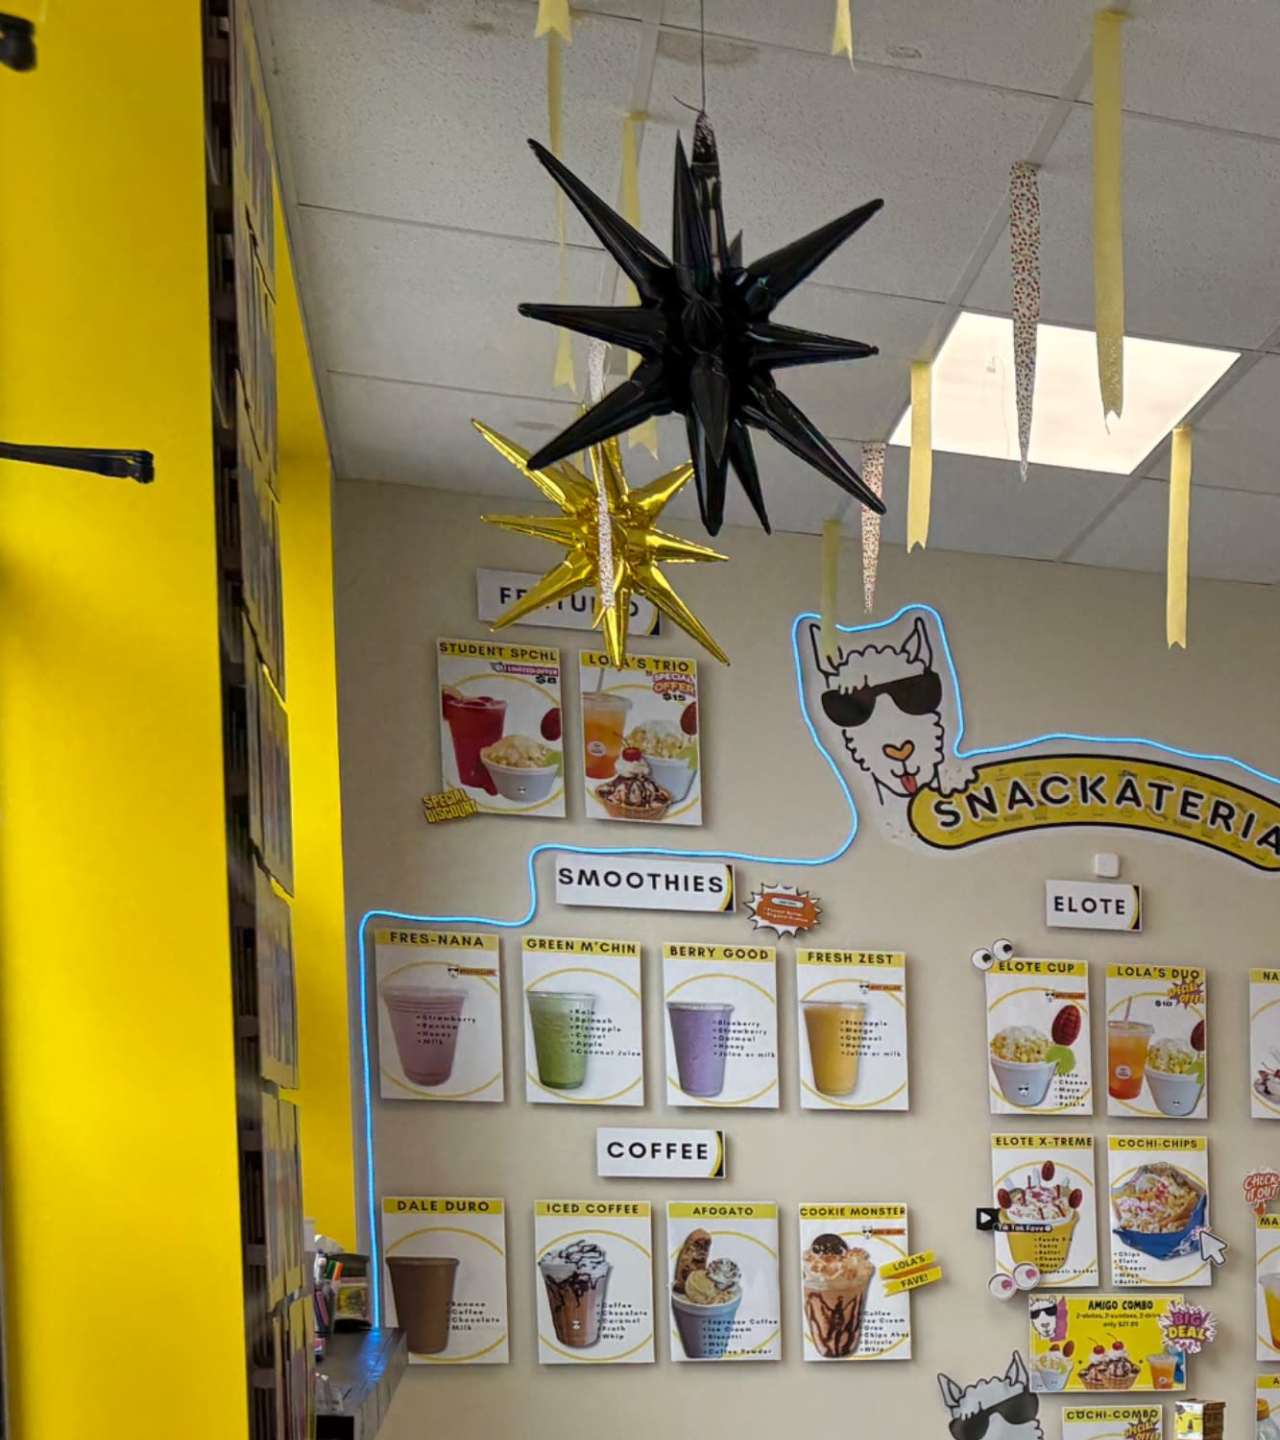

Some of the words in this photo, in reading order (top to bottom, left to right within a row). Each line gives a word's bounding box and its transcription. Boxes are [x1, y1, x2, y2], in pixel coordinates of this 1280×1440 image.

[439, 641, 505, 658] STUDENT
[510, 643, 558, 662] SPCHL
[652, 658, 689, 672] TRIO
[558, 866, 724, 894] SMOOTHIES
[1054, 895, 1126, 916] ELOTE
[389, 933, 486, 948] FRES-NANA
[526, 936, 575, 953] GREEN
[670, 945, 717, 960] BERRY
[724, 947, 769, 962] GOOD
[807, 950, 853, 965] FRESH
[858, 952, 894, 966] ZEST
[999, 961, 1045, 972] ELOTE
[1047, 962, 1075, 973] CUP
[1117, 966, 1168, 979] LOLA'S
[1171, 969, 1200, 980] DUO
[995, 1137, 1034, 1146] ELOTE
[1039, 1137, 1093, 1147] X-TREME
[606, 1141, 709, 1161] COFFEE
[1243, 1173, 1280, 1190] CHECK
[397, 1199, 439, 1213] DALE
[444, 1199, 490, 1213] DURO
[546, 1203, 580, 1215] ICED
[586, 1203, 639, 1216] COFFEE
[692, 1205, 754, 1217] AFOGATO
[800, 1205, 847, 1217] COOKIE
[850, 1205, 906, 1218] MONSTER
[891, 1255, 926, 1272] LOLA'S
[900, 1273, 929, 1288] FAVE!
[1088, 1300, 1118, 1310] AMIGO
[1121, 1300, 1154, 1310] COMBO
[1173, 1311, 1201, 1325] BIG
[1168, 1325, 1206, 1340] DEAL
